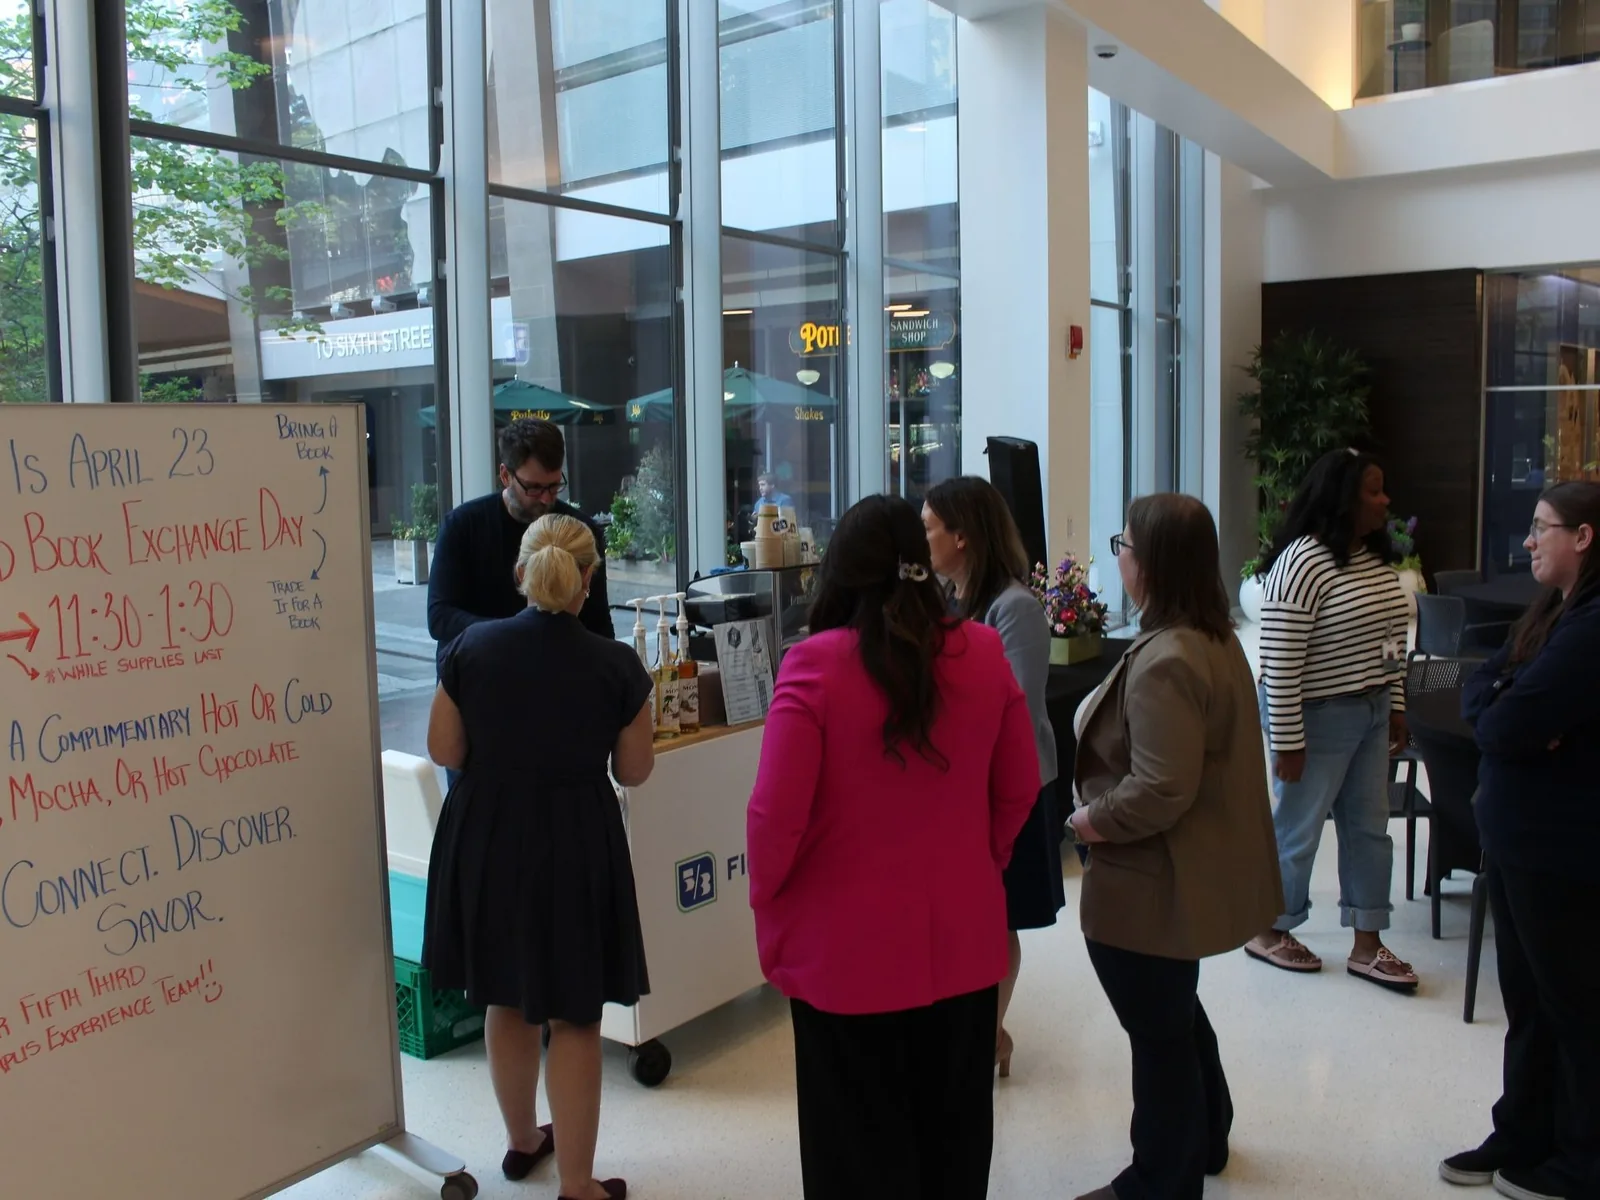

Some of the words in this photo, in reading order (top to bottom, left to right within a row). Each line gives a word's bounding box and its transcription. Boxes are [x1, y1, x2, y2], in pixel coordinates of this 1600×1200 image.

[313, 338, 333, 360] TO
[337, 332, 378, 357] SIXTH
[381, 325, 434, 352] STREE
[890, 318, 939, 332] SANDWICH
[901, 331, 927, 343] SHOP
[329, 414, 338, 438] A
[795, 406, 824, 421] Shakes
[168, 427, 215, 479] 23
[122, 499, 252, 567] EXCHANGE
[259, 487, 304, 552] DAY
[117, 653, 185, 673] SUPPLIES
[194, 648, 225, 666] LAST
[8, 719, 26, 762] A
[38, 706, 192, 763] COMPLIMENTARY
[200, 691, 240, 735] HOT
[284, 678, 333, 725] COLD
[153, 755, 192, 796] HOT
[198, 740, 301, 785] CHOCOLATE
[19, 986, 83, 1025] FIFTH
[78, 965, 147, 998] THIRD
[45, 995, 156, 1052] EXPERIENCE
